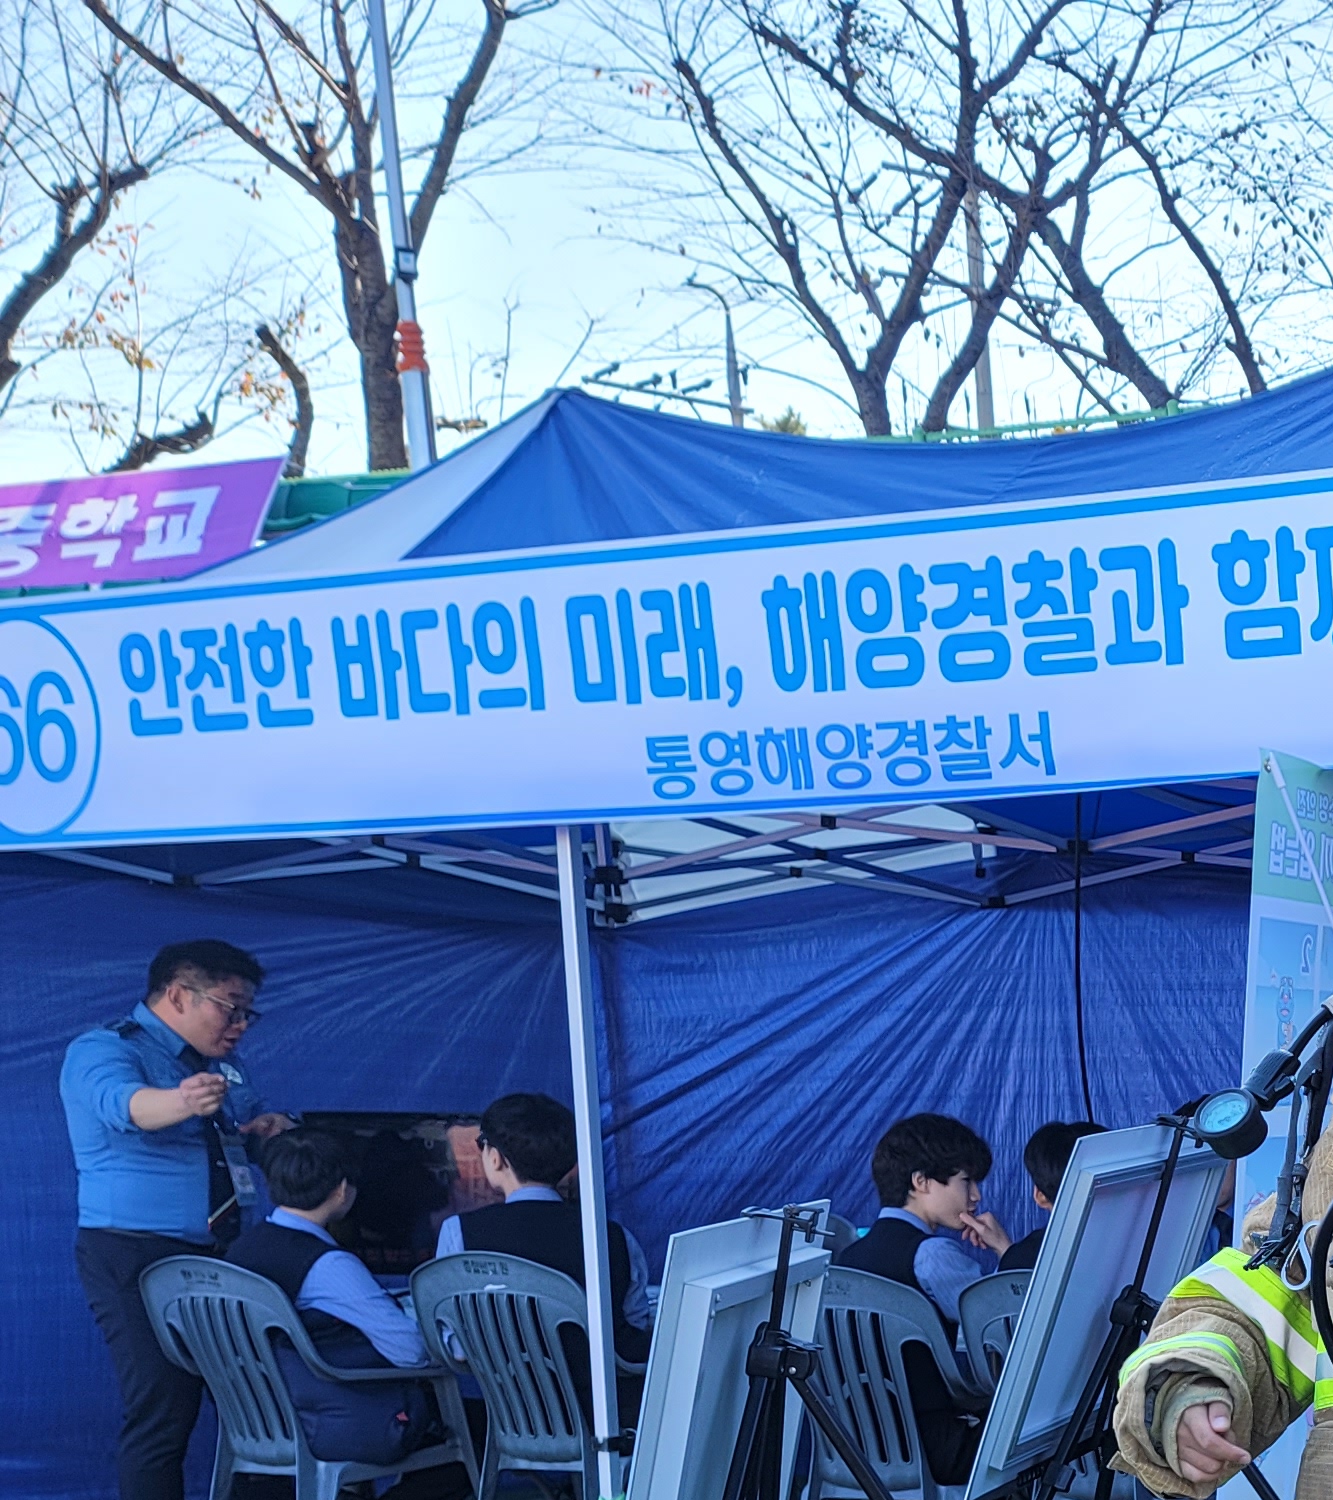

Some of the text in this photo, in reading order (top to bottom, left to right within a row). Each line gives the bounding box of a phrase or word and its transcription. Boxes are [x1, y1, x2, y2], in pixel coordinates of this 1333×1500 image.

[117, 618, 313, 738] 안전한
[331, 596, 546, 720] 바다의
[565, 581, 742, 709] 미래,
[760, 537, 1189, 693] 해양경찰과
[645, 711, 1057, 800] 통영해양경찰서
